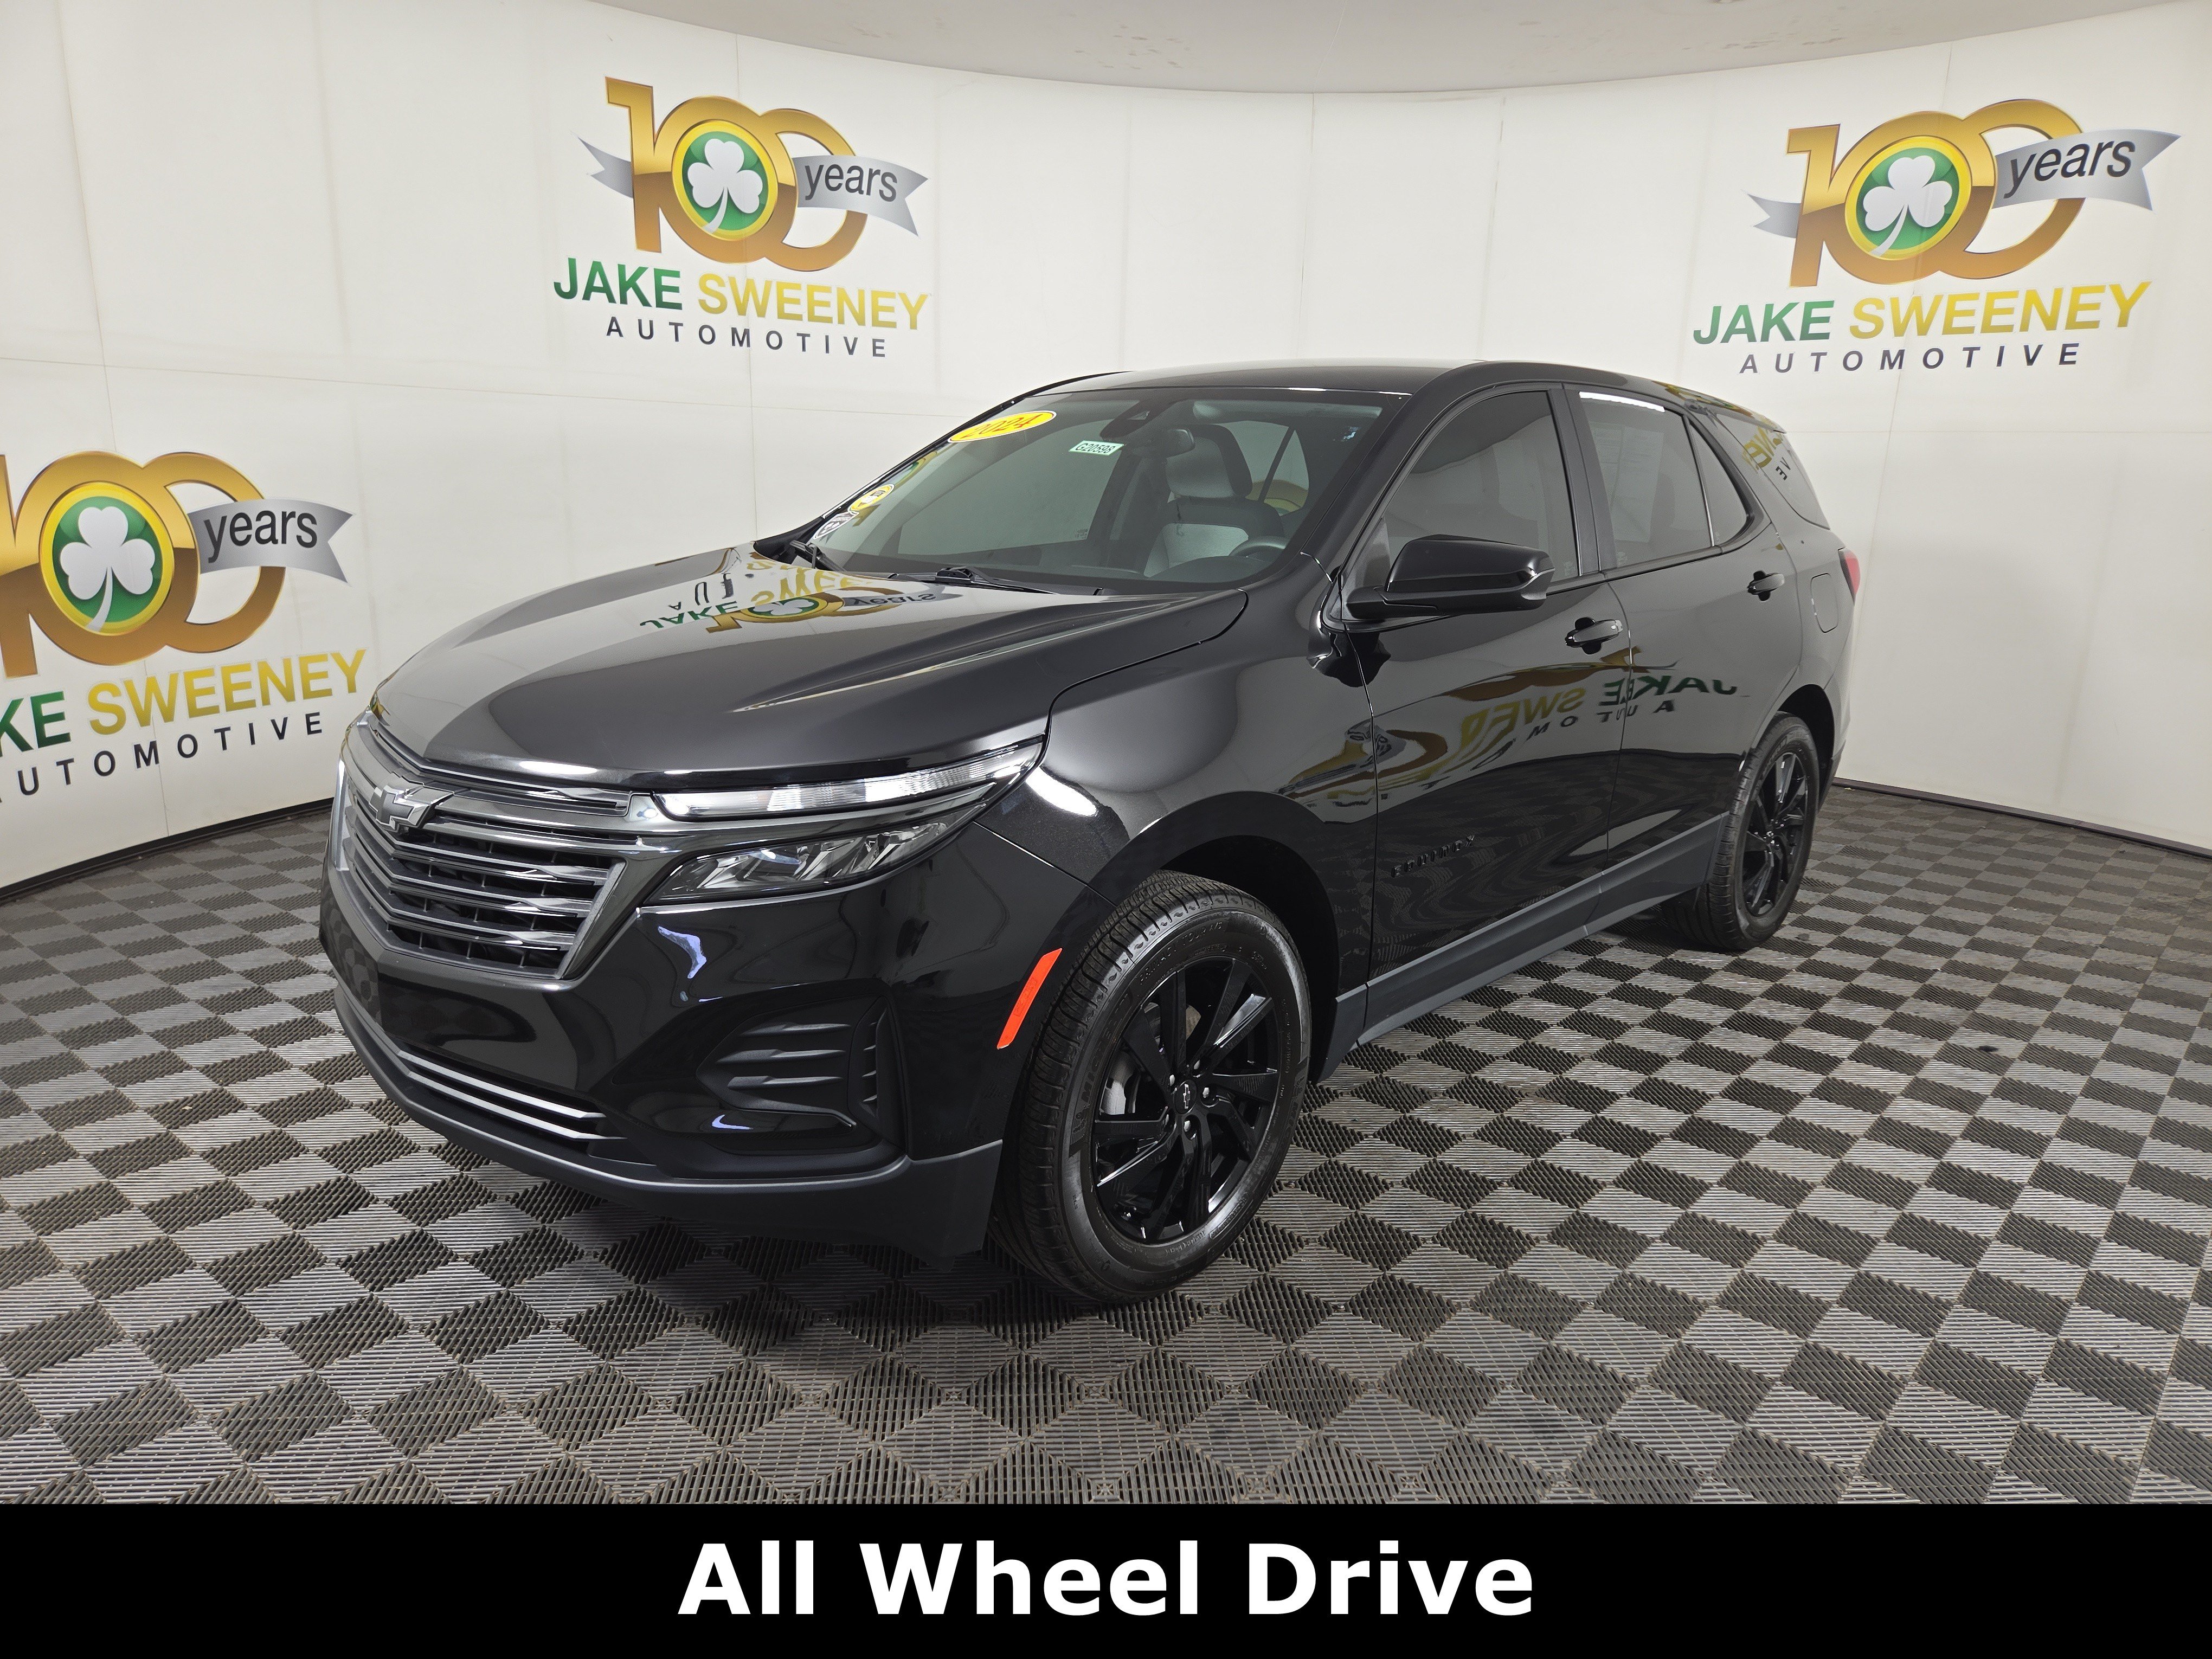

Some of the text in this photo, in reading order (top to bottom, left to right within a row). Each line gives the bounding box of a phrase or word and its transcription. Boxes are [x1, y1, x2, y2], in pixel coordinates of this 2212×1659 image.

[605, 76, 898, 272] 100 years
[1786, 99, 2136, 288] 100 years
[554, 257, 929, 330] JAKE SWEENEY
[1693, 281, 2152, 345] JAKE SWEENEY
[606, 316, 886, 358] AUTOMOTIVE
[1740, 343, 2080, 375] AUTOMOTIVE
[960, 414, 1044, 439] 2024
[1076, 442, 1116, 454] G20598
[203, 509, 318, 564] years
[87, 649, 367, 735] SWEENEY
[0, 711, 322, 803] UTOMOTIVE
